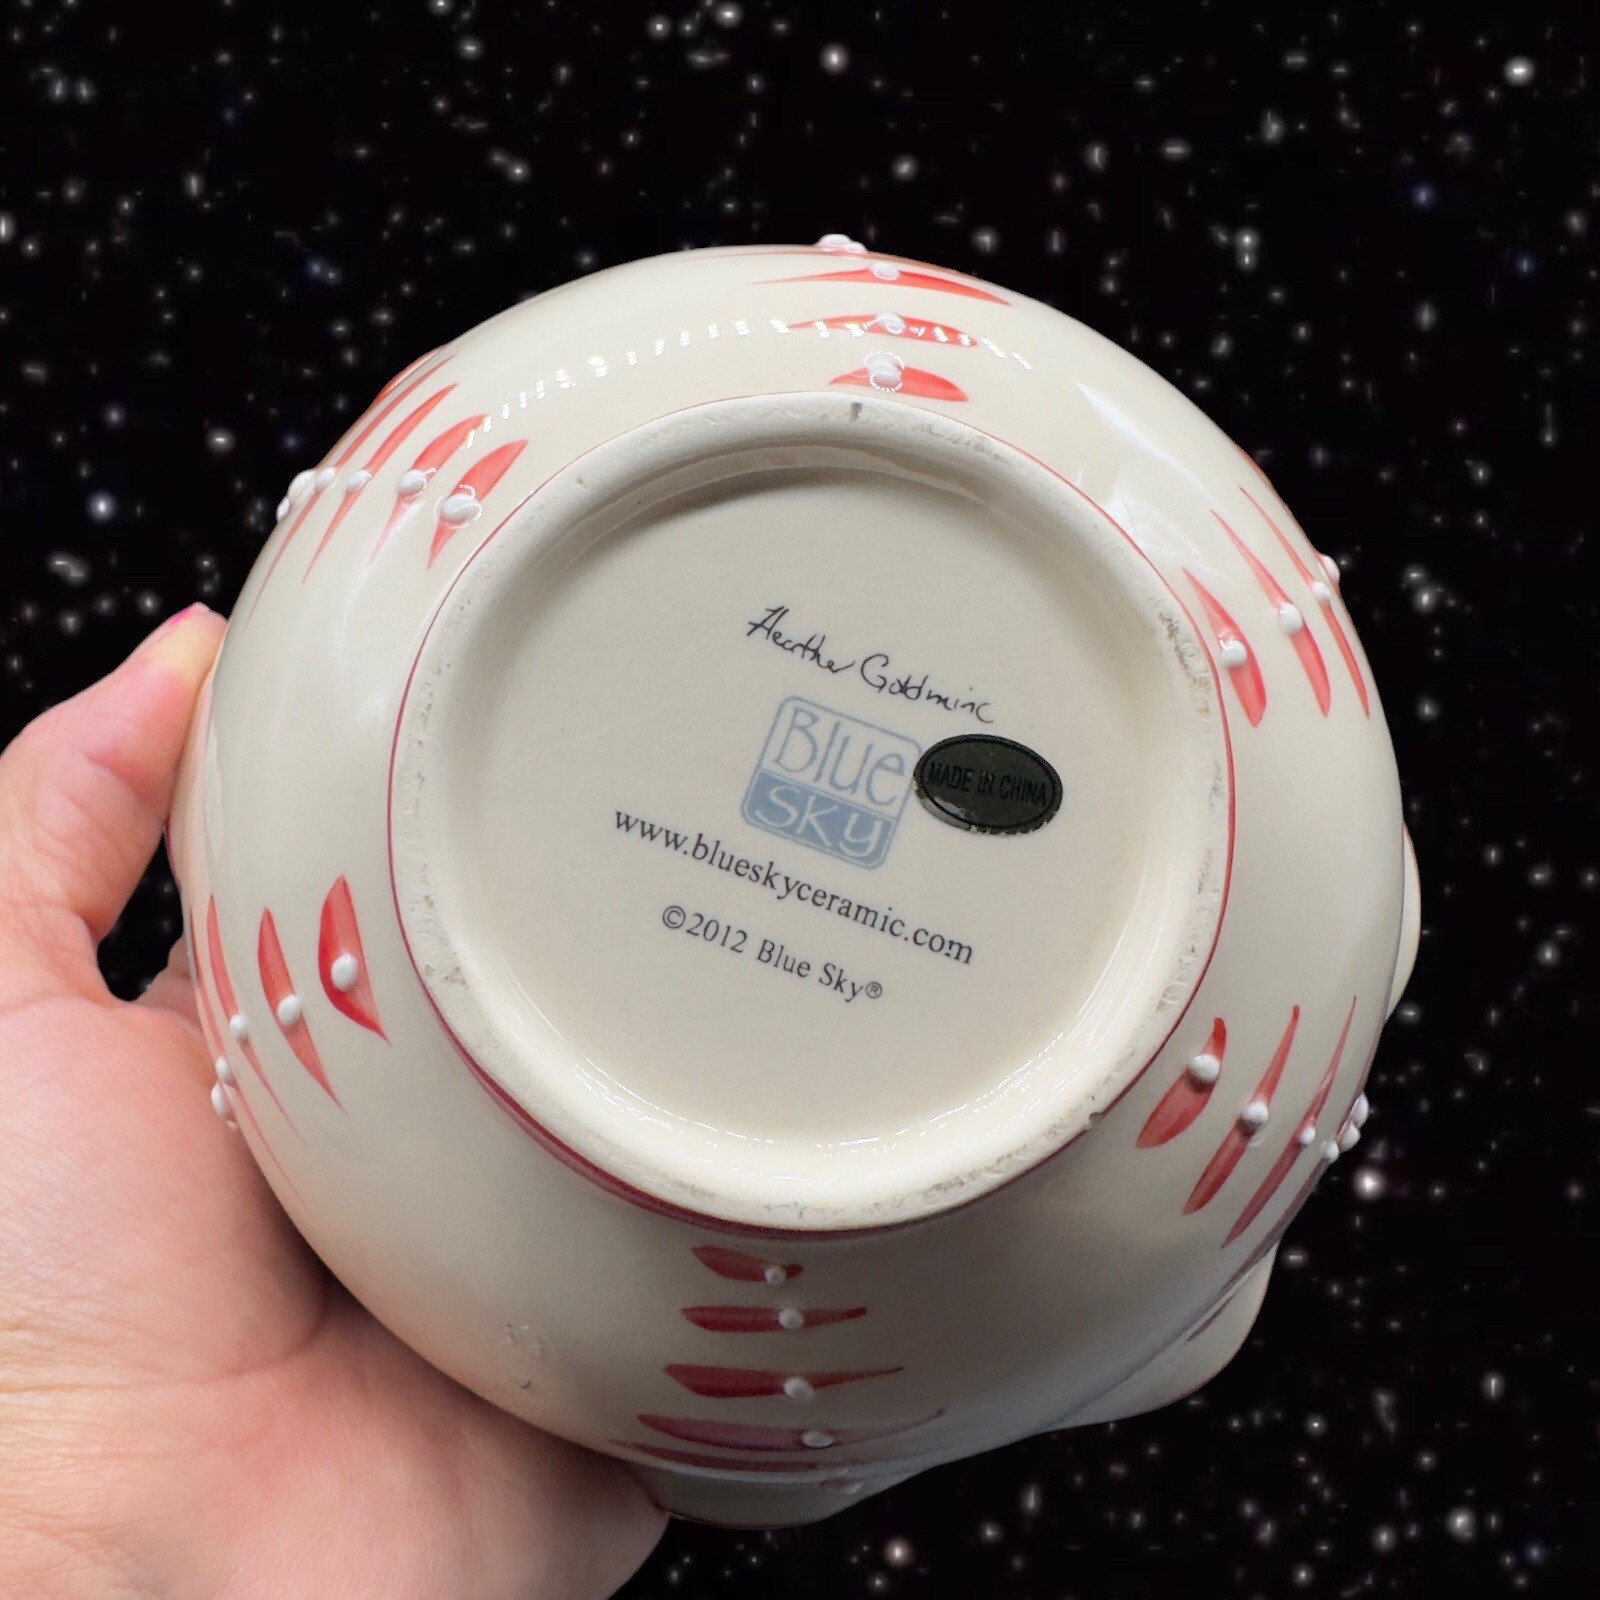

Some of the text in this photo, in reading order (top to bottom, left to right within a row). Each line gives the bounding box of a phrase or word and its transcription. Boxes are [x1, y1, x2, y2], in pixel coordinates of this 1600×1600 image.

[772, 706, 906, 806] Blue
[927, 760, 1048, 807] MADE IN CHINA
[615, 810, 974, 966] www.blueskyceramic.com
[756, 938, 812, 979] Blue
